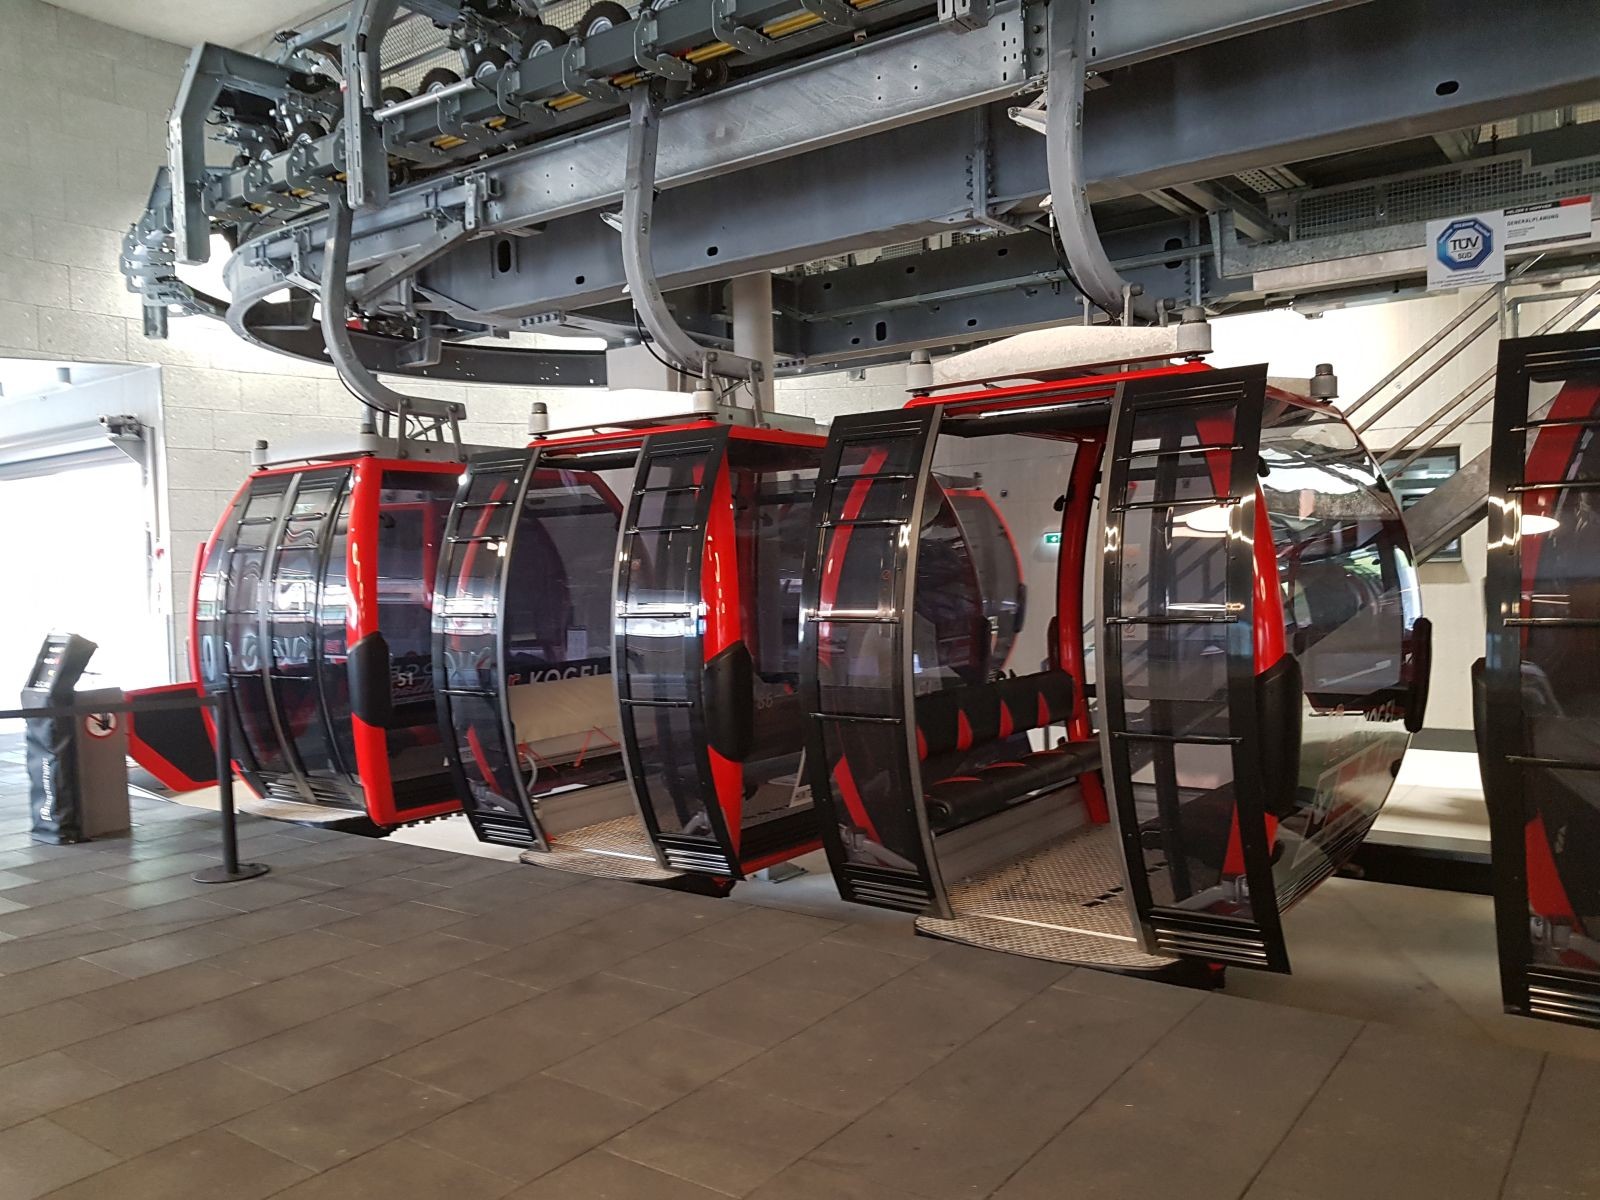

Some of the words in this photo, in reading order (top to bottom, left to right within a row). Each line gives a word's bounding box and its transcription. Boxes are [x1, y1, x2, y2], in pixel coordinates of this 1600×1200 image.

[1507, 214, 1559, 226] GENERALPLANUNG
[1450, 236, 1479, 250] TÜV
[1457, 252, 1472, 260] SÜD
